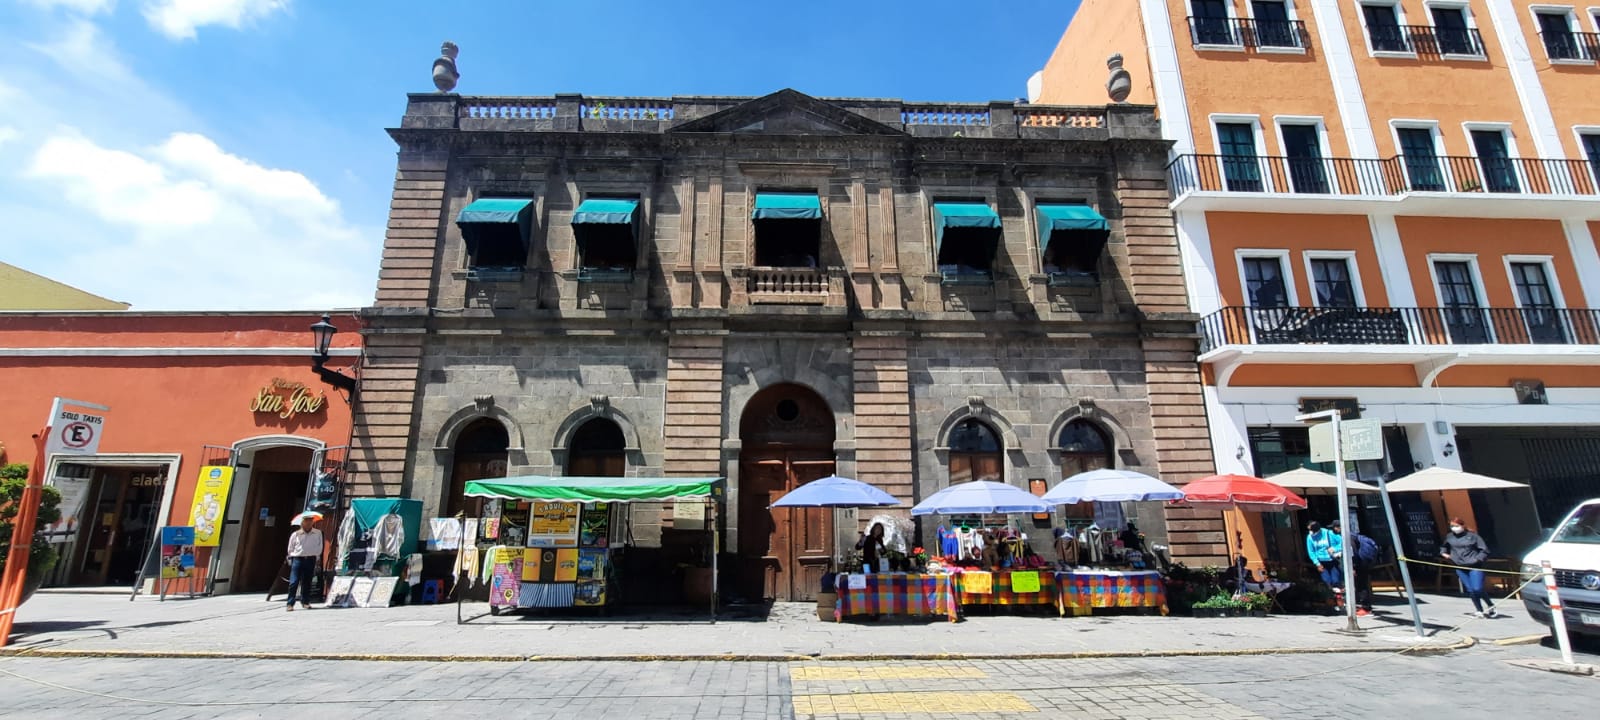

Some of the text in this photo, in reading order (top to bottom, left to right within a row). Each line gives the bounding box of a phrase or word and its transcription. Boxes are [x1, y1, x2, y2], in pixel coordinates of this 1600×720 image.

[249, 386, 325, 419] San José
[61, 411, 102, 425] SOLO TAXIS
[71, 425, 86, 442] E
